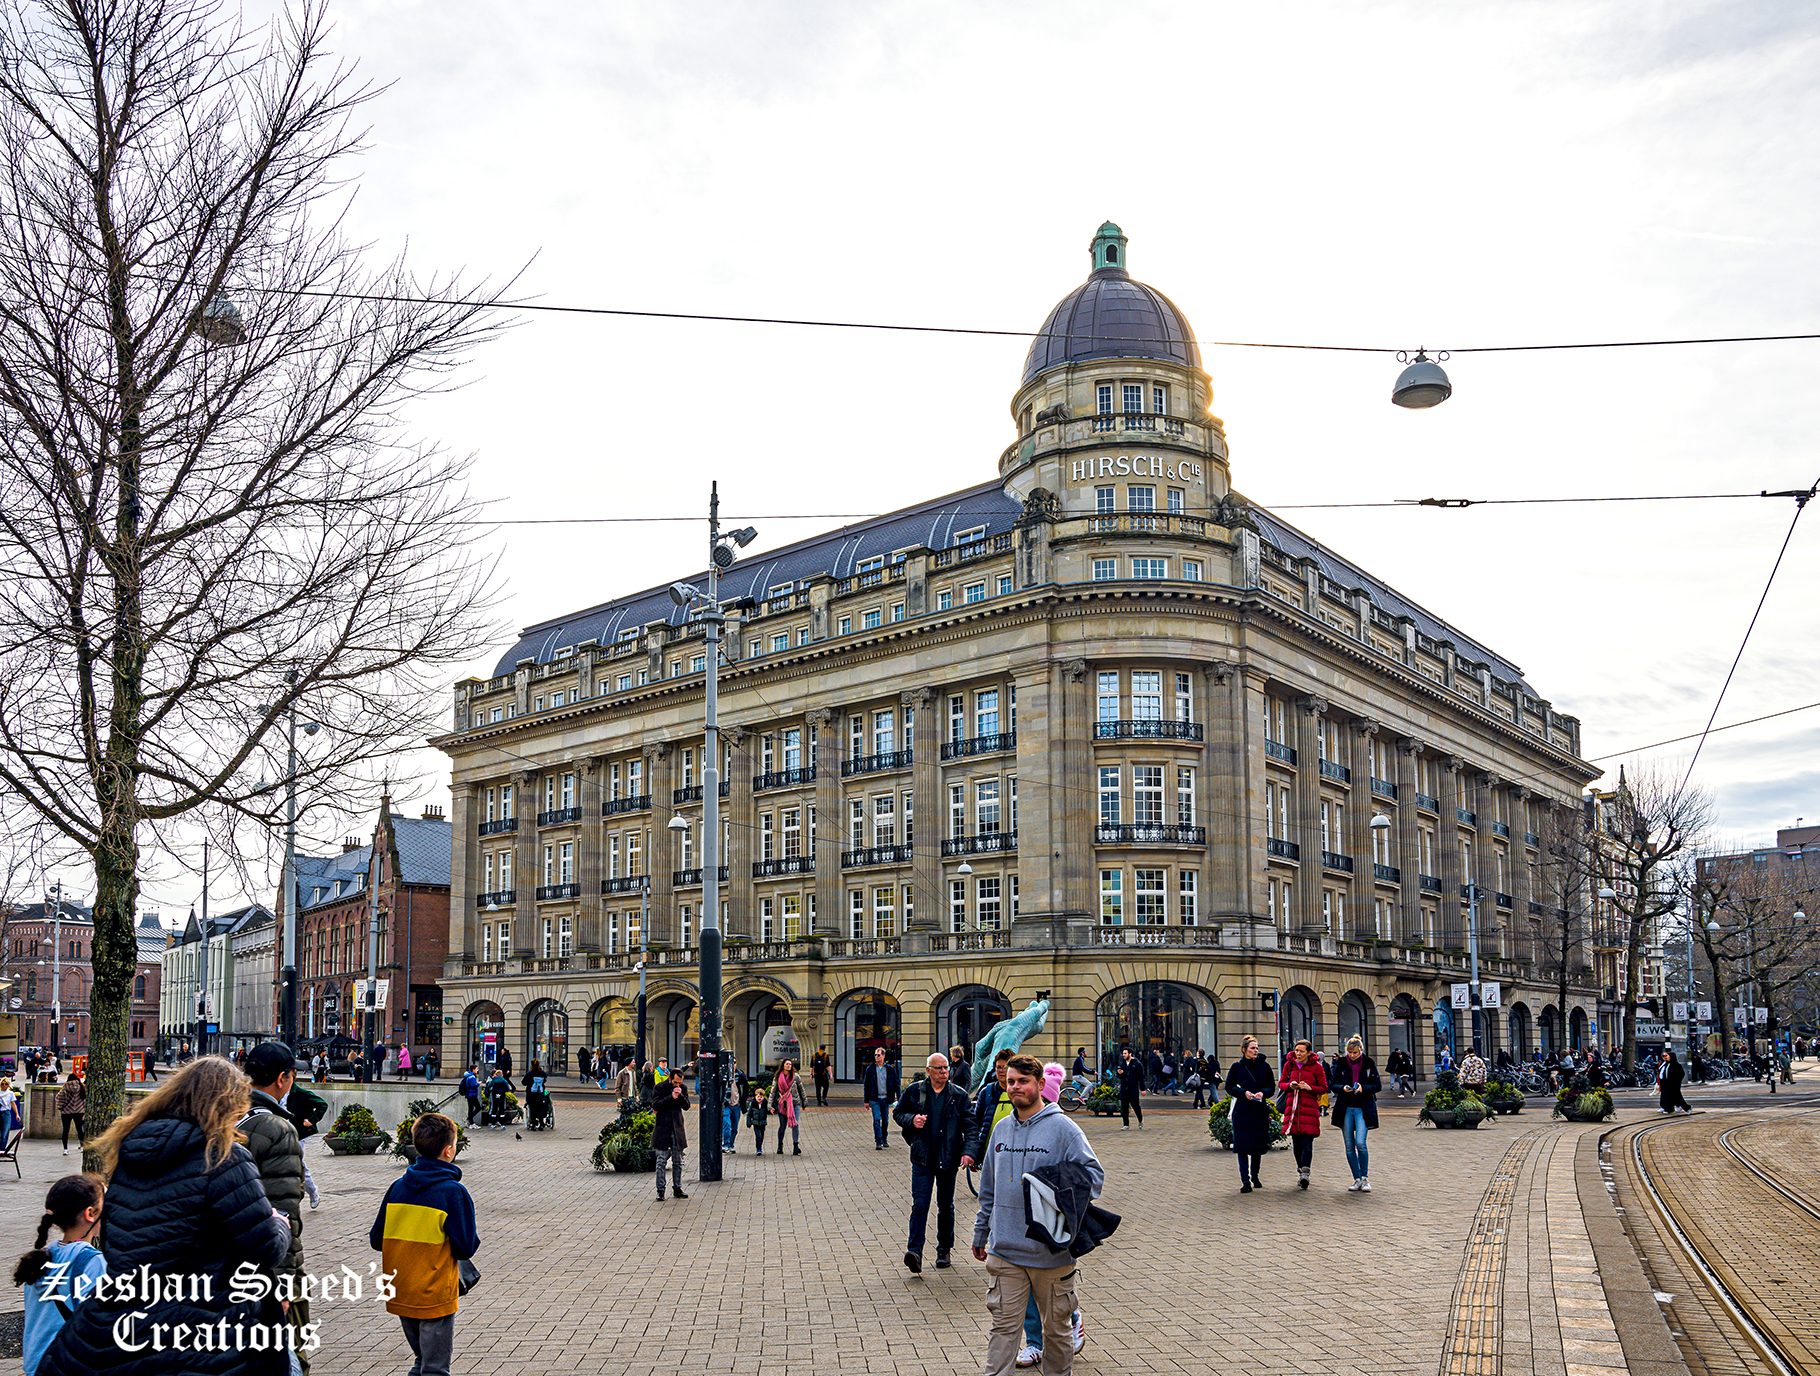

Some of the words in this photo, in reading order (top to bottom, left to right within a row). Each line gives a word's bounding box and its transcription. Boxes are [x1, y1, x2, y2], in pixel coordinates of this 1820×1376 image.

[1072, 455, 1164, 481] HIRSCH
[1166, 464, 1177, 481] &
[995, 1142, 1050, 1157] Champion
